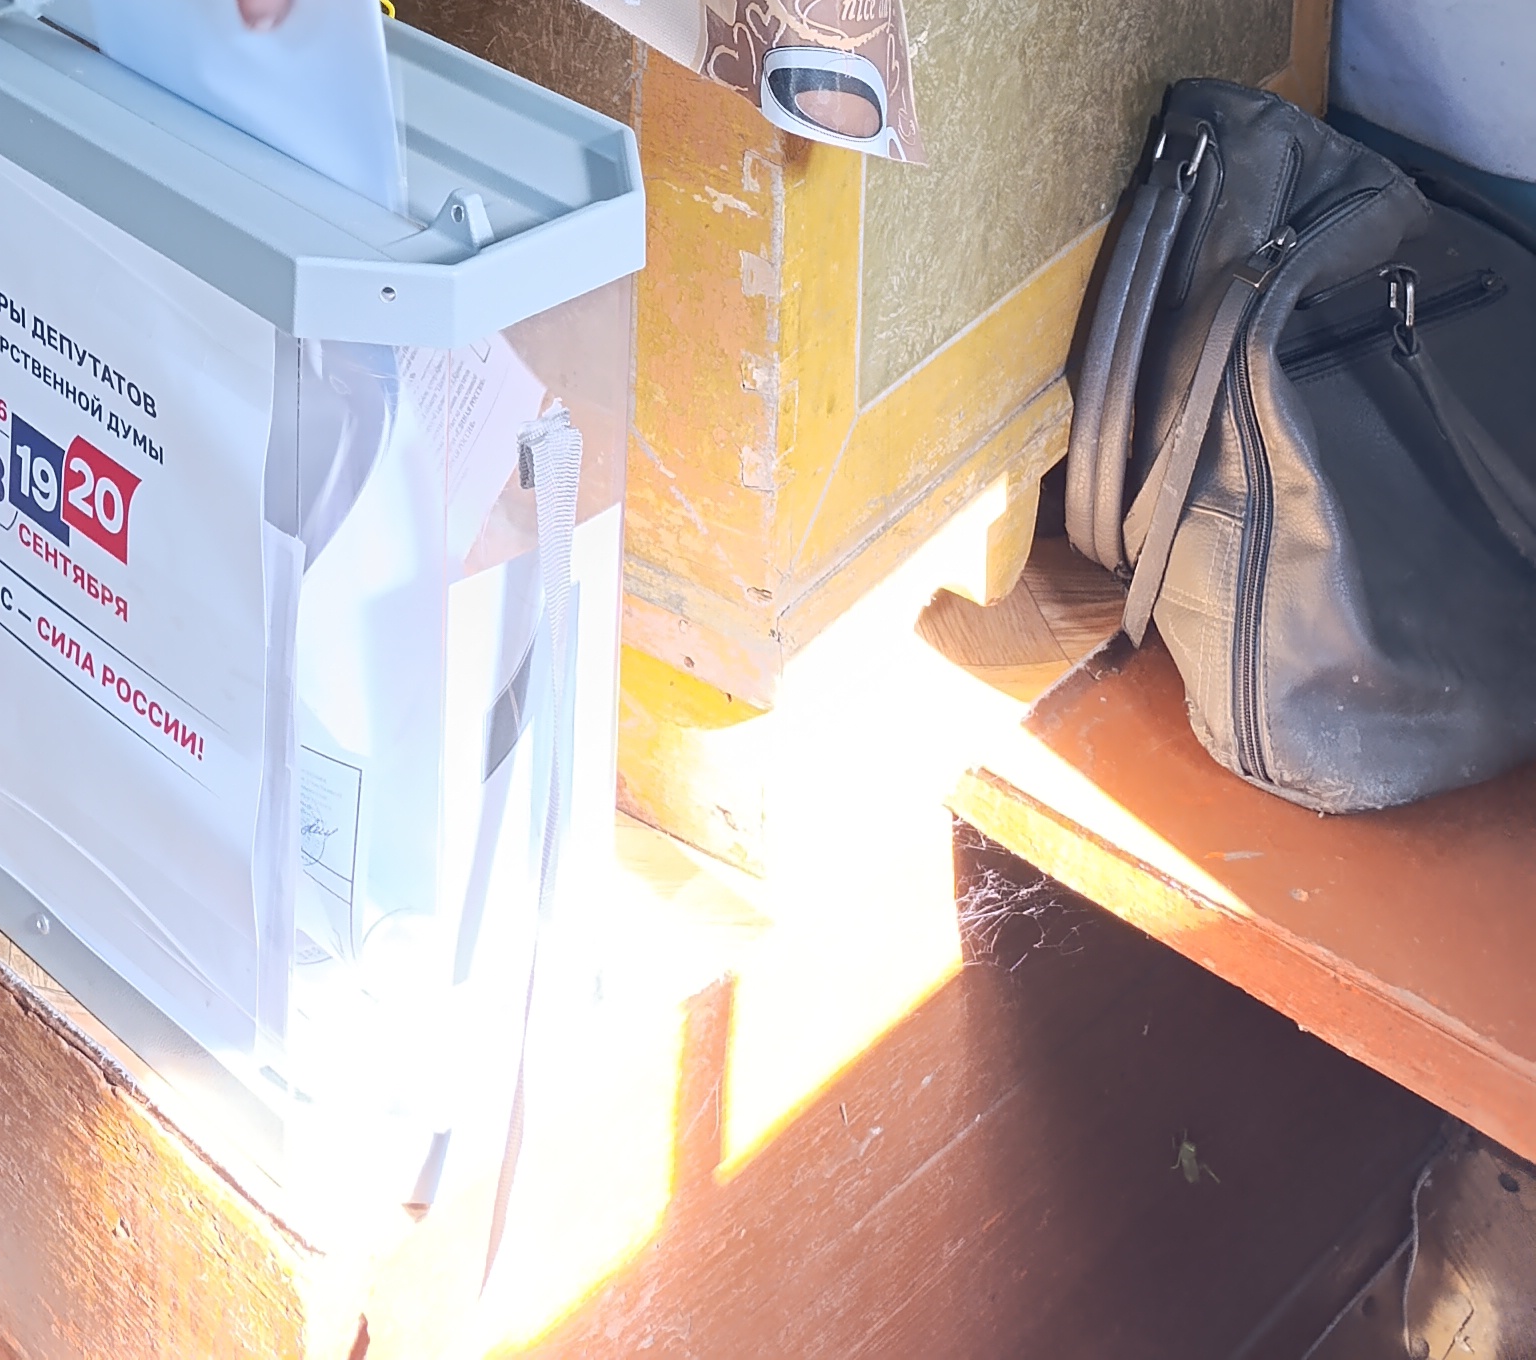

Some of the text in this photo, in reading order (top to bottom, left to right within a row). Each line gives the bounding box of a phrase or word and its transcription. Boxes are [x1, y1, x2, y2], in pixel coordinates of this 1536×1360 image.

[32, 315, 158, 419] ДЕПУТАТОВ
[107, 411, 165, 465] ДУМЫ
[16, 443, 59, 514] 19
[67, 456, 123, 535] 20
[19, 521, 129, 622] СЕНТЯБРЯ
[36, 616, 95, 678] СИЛА
[102, 668, 205, 761] РОССИИ!
